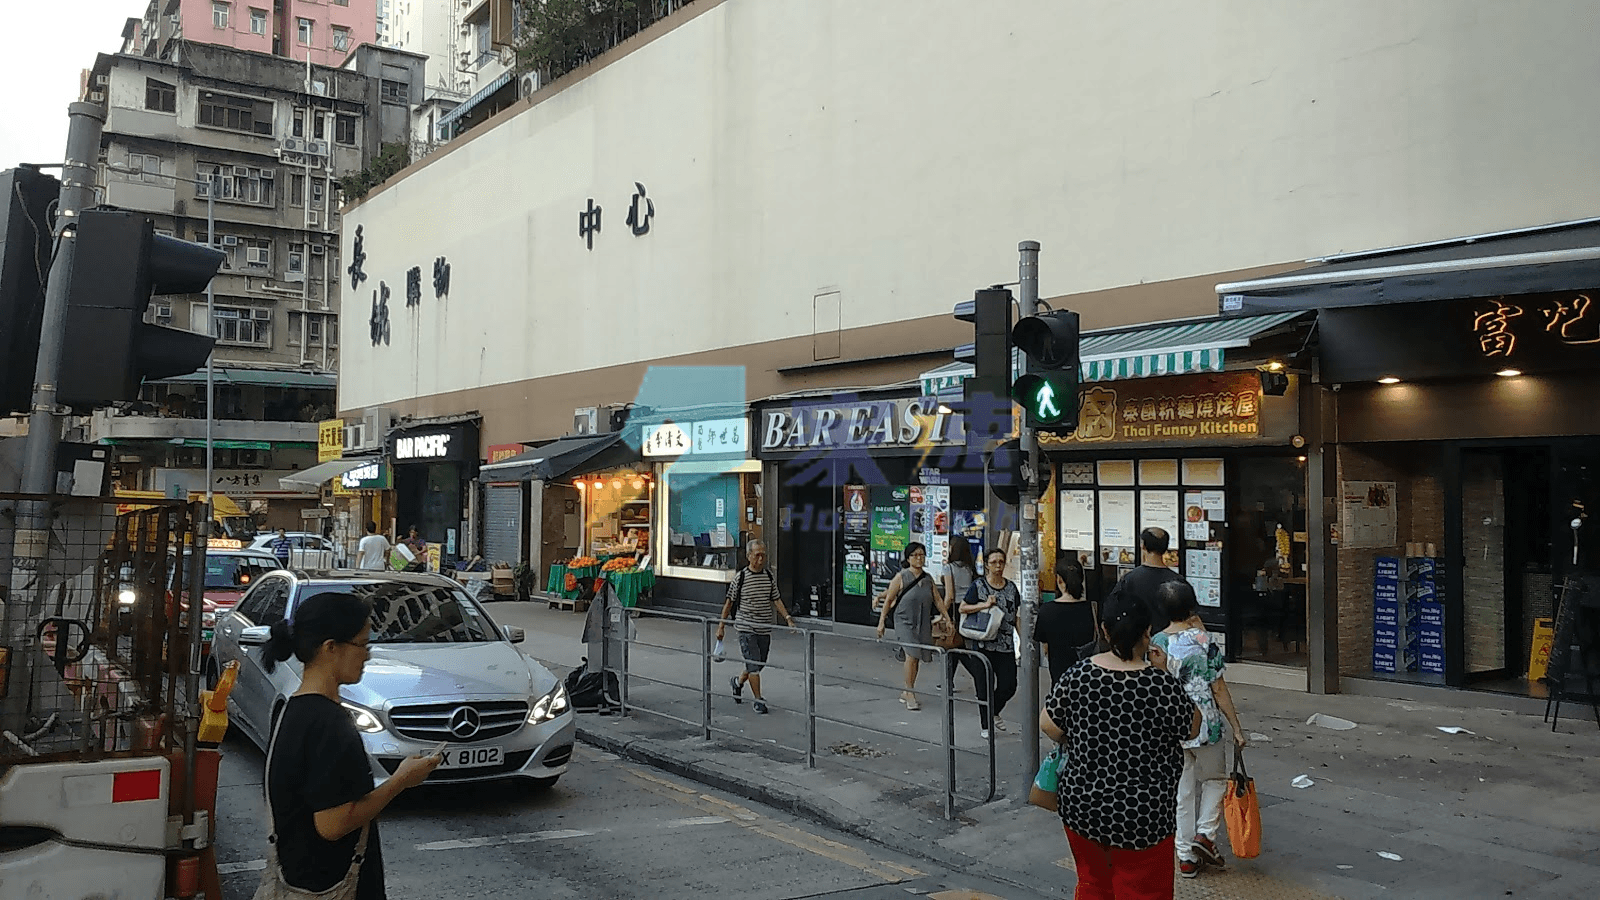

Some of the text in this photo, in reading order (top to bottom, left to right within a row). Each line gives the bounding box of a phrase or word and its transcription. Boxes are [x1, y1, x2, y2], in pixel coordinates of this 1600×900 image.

[762, 401, 948, 448] BAR EAST
[1122, 420, 1257, 438] Thai Funny Kitchen
[397, 434, 449, 459] BAR PACIFIC
[918, 467, 941, 476] STAR
[458, 748, 499, 765] 8102
